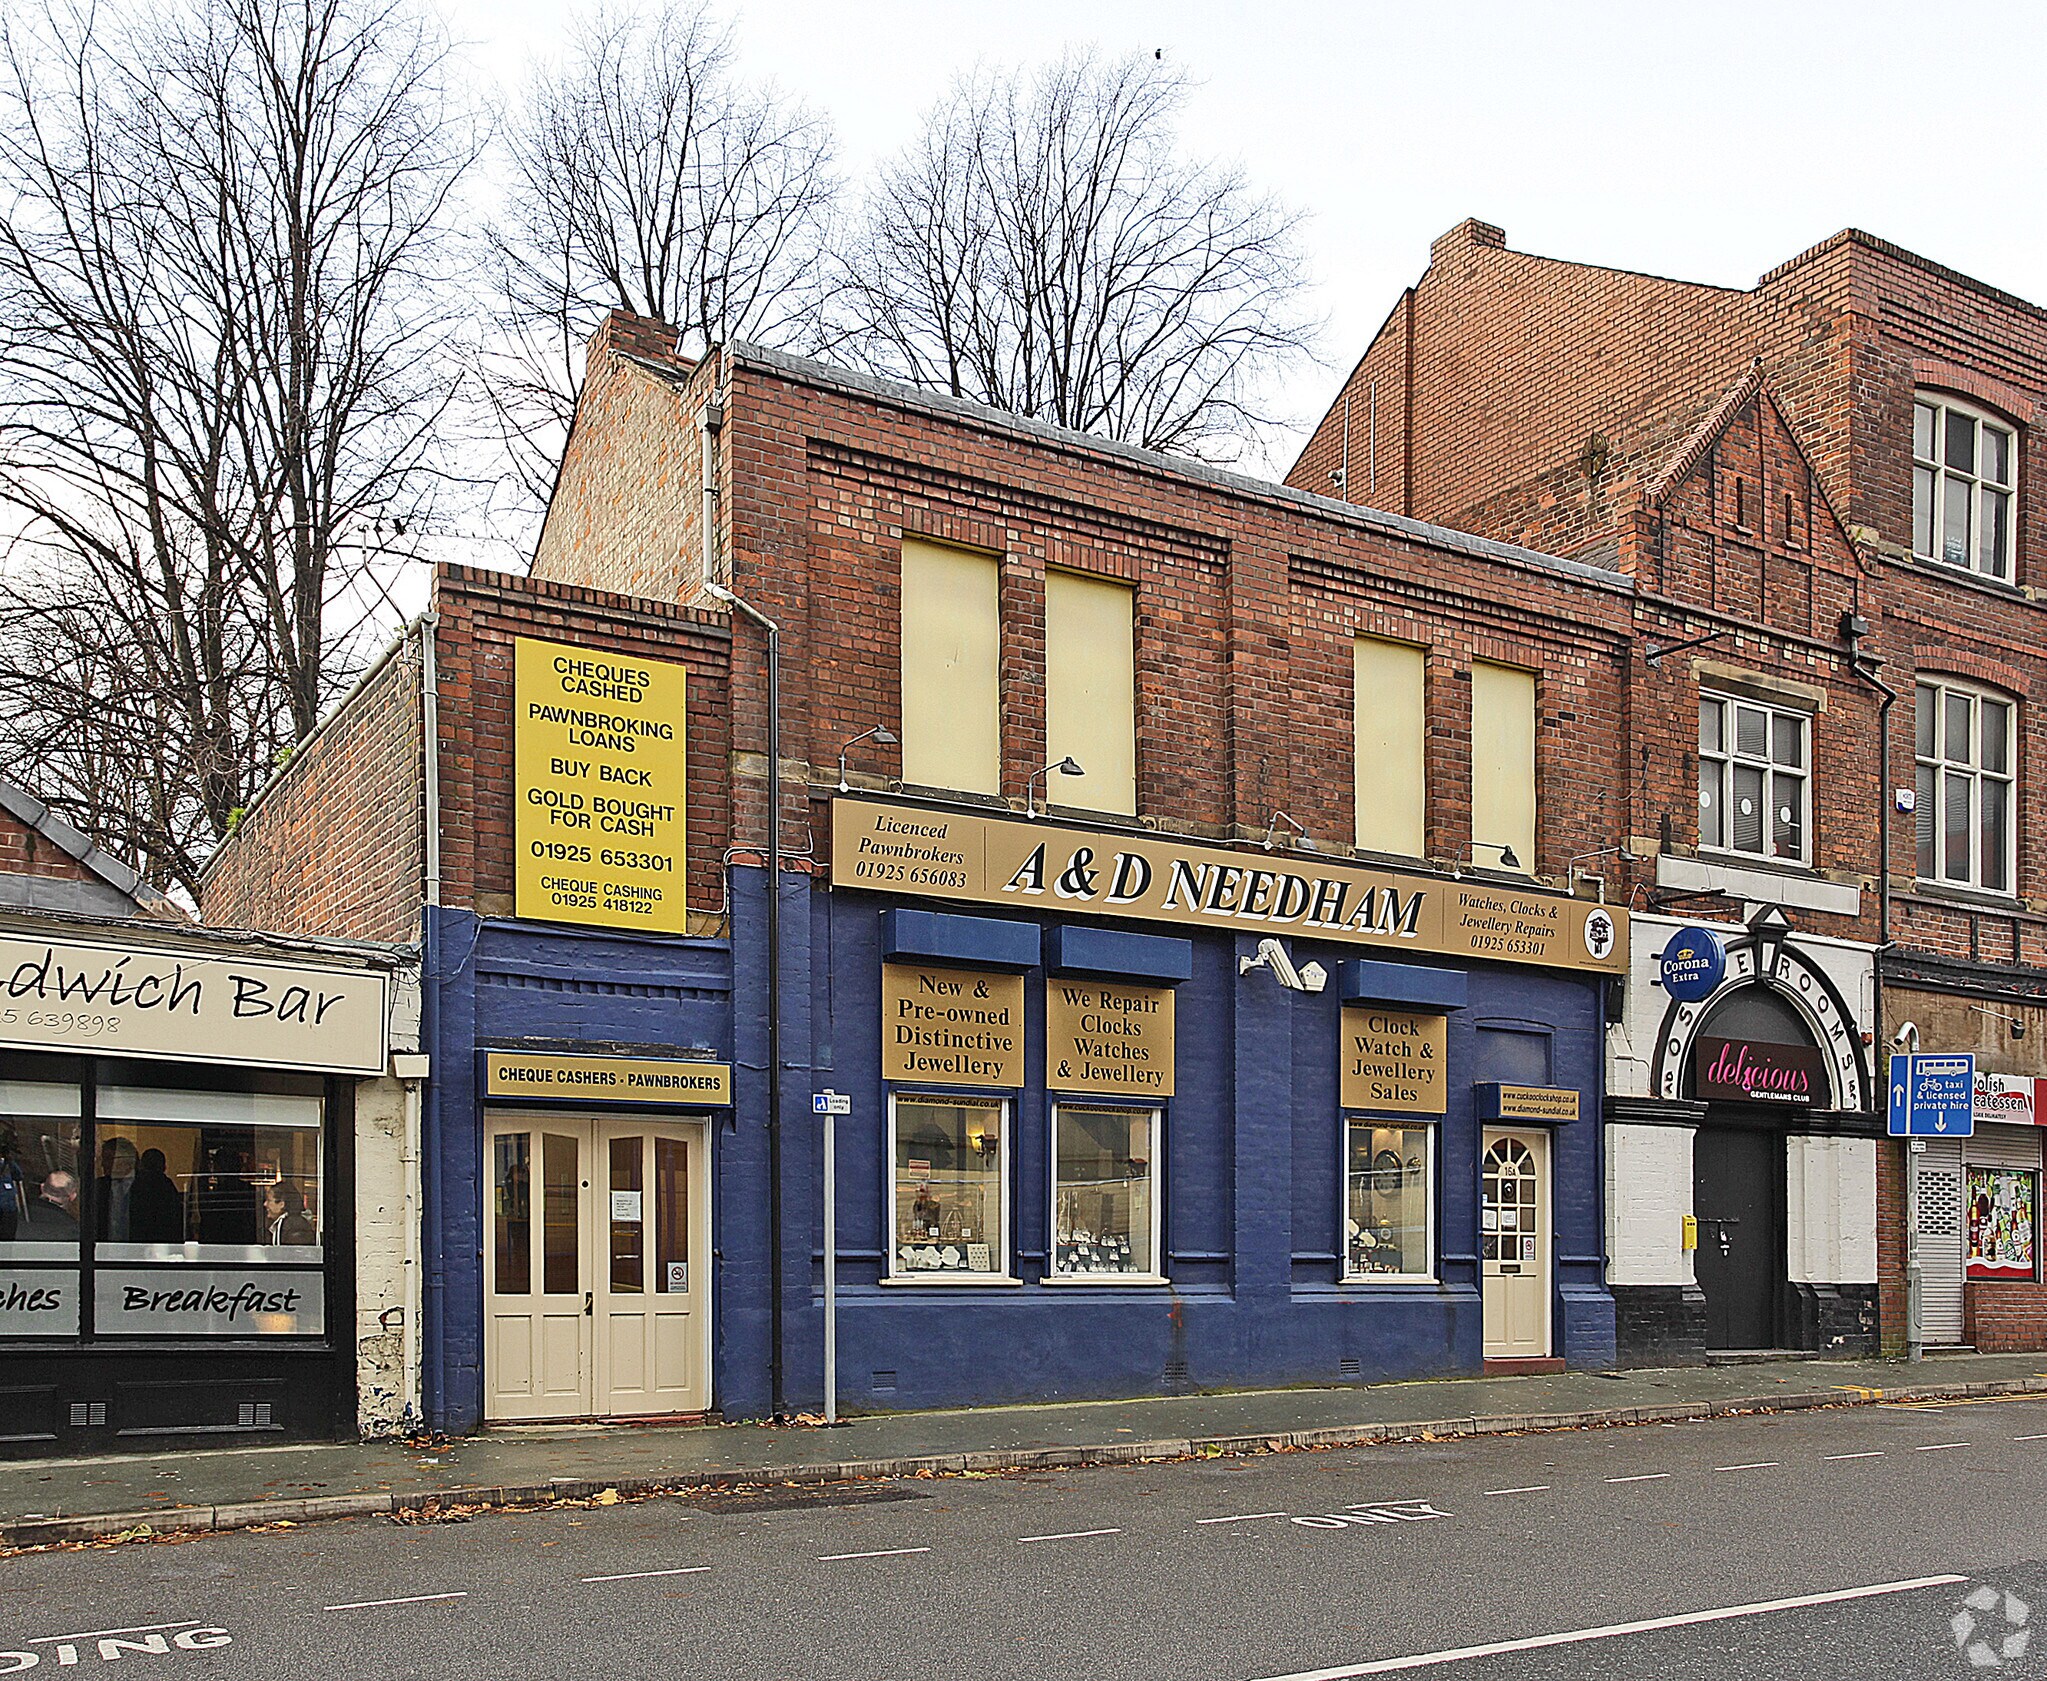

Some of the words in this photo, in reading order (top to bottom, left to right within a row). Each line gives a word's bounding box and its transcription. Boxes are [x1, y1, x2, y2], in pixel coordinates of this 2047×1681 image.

[553, 657, 650, 688] CHEQUES
[561, 677, 643, 703] CASHED
[529, 703, 673, 740] PAWNBROKING
[569, 728, 635, 752] LOANS
[551, 758, 591, 778] BUY
[600, 765, 652, 787] BACK
[528, 788, 584, 810] GOLD
[593, 797, 675, 822] BOUGHT
[550, 810, 591, 830] FOR
[600, 816, 654, 837] CASH
[874, 815, 948, 840] Licenced
[531, 840, 592, 863] 01925
[600, 849, 673, 872] 653301
[858, 836, 964, 866] Pawnbrokers
[855, 860, 905, 882] 01925
[909, 867, 967, 889] 656083
[541, 876, 598, 895] CHEQUE
[603, 883, 663, 901] CASHING
[1001, 841, 1048, 895] A
[1053, 846, 1100, 901] &
[1103, 851, 1153, 904] D
[1160, 859, 1427, 938] NEEDHAM
[551, 892, 597, 909] 01925
[602, 898, 653, 915] 418122
[1458, 892, 1506, 914] Watches,
[1509, 899, 1547, 919] Clocks
[1548, 905, 1559, 920] &
[1459, 913, 1513, 936] Jewellery
[1514, 919, 1556, 939] Repairs
[1470, 934, 1505, 953] 01925
[1506, 938, 1546, 957] 653301
[1663, 958, 1709, 975] Corona
[1672, 973, 1699, 983] Extra
[0, 948, 203, 1015] dwich
[228, 974, 346, 1025] Bar
[919, 974, 964, 998] New
[973, 979, 990, 999] &
[898, 998, 1011, 1026] Pre-owned
[1061, 987, 1091, 1008] We
[1099, 992, 1160, 1015] Repair
[0, 1009, 21, 1024] 5
[27, 1011, 121, 1037] 639898
[1080, 1014, 1142, 1037] Clocks
[1368, 1016, 1420, 1037] Clock
[895, 1024, 1013, 1052] Distinctive
[1073, 1037, 1149, 1062] Watches
[1354, 1036, 1412, 1058] Watch
[1419, 1042, 1434, 1060] &
[903, 1051, 1004, 1079] Jewellery
[1056, 1059, 1072, 1079] &
[1080, 1060, 1165, 1087] Jewellery
[1351, 1058, 1436, 1084] Jewellery
[1708, 1042, 1809, 1092] delicious
[499, 1067, 553, 1083] CHEQUE
[557, 1069, 617, 1086] CASHERS
[628, 1073, 721, 1091] PAWNBROKERS
[1370, 1081, 1418, 1102] Sales
[1945, 1079, 1964, 1089] taxi
[897, 1095, 1000, 1108] www.diamond-sundial.co.uk
[1750, 1090, 1792, 1101] GENTLEMANS
[1793, 1094, 1810, 1102] CLUB
[1914, 1101, 1949, 1112] private
[1950, 1101, 1969, 1111] hire
[1916, 1091, 1924, 1100] &
[1926, 1091, 1966, 1101] licensed
[1974, 1094, 2024, 1111] catessen
[1504, 1167, 1516, 1176] 16A
[123, 1282, 301, 1321] Breakfast
